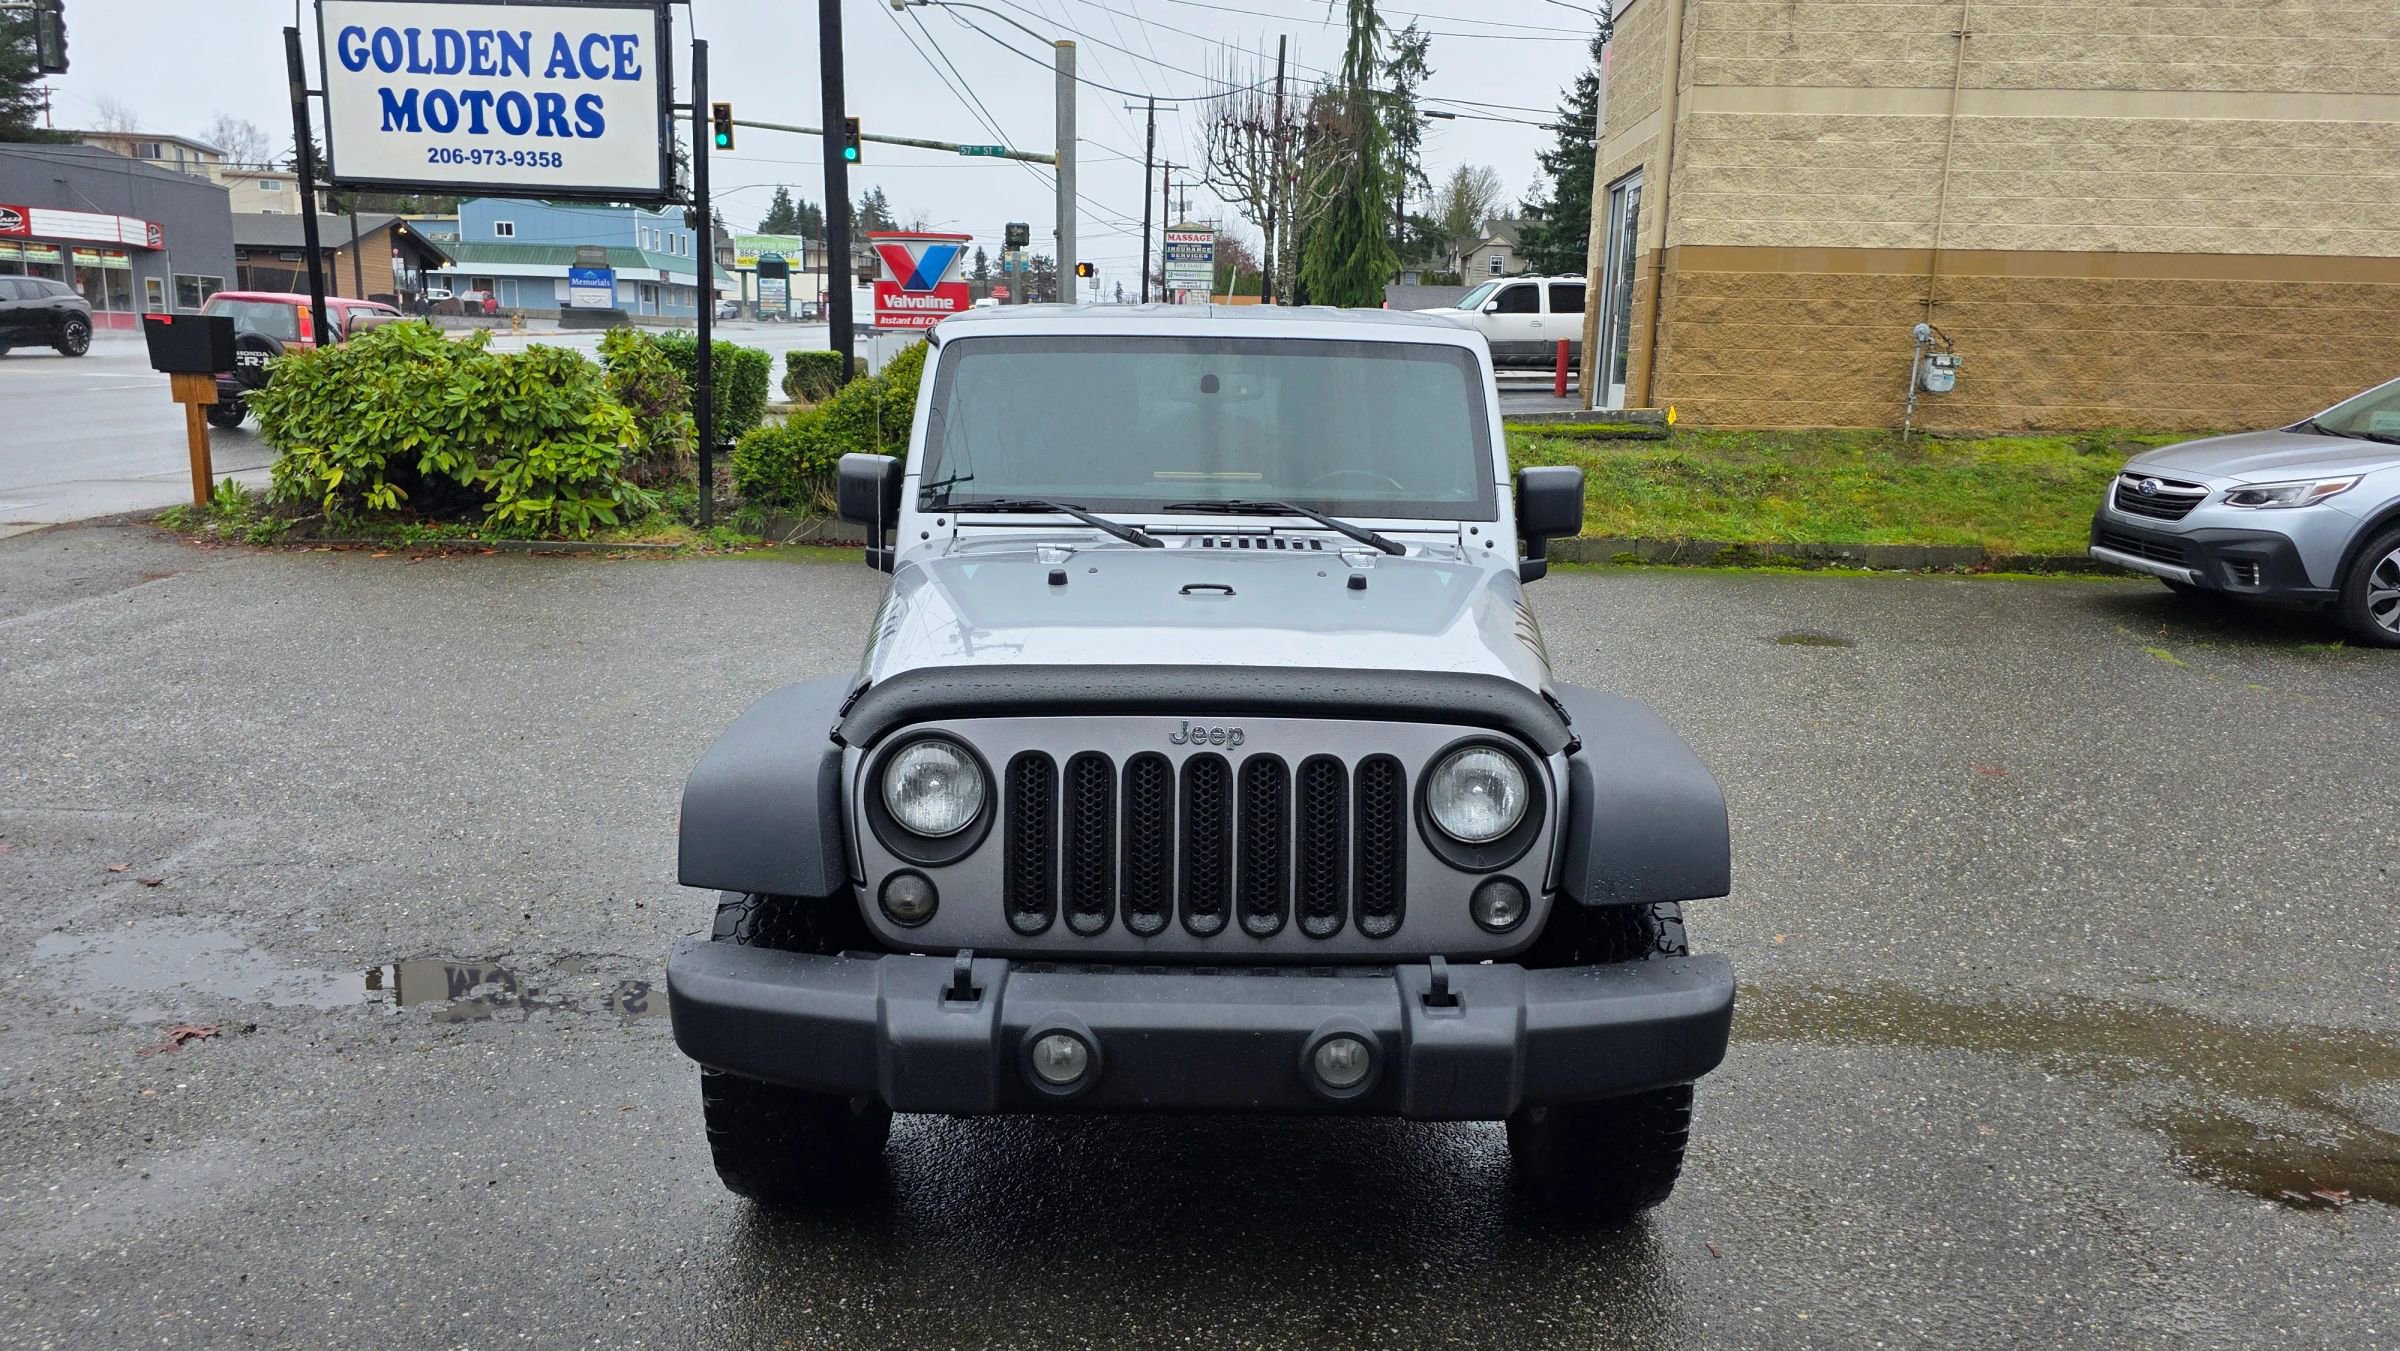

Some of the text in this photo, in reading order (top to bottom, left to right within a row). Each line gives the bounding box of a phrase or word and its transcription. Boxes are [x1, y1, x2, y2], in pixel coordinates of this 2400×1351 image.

[338, 25, 642, 81] GOLDEN ACE
[378, 86, 606, 139] MOTORS
[427, 147, 563, 168] 206-973-9358
[571, 278, 610, 286] Memorials
[883, 294, 955, 309] Valvoline
[880, 316, 910, 325] Instant
[912, 316, 925, 325] Oil
[1169, 719, 1245, 751] Jeep
